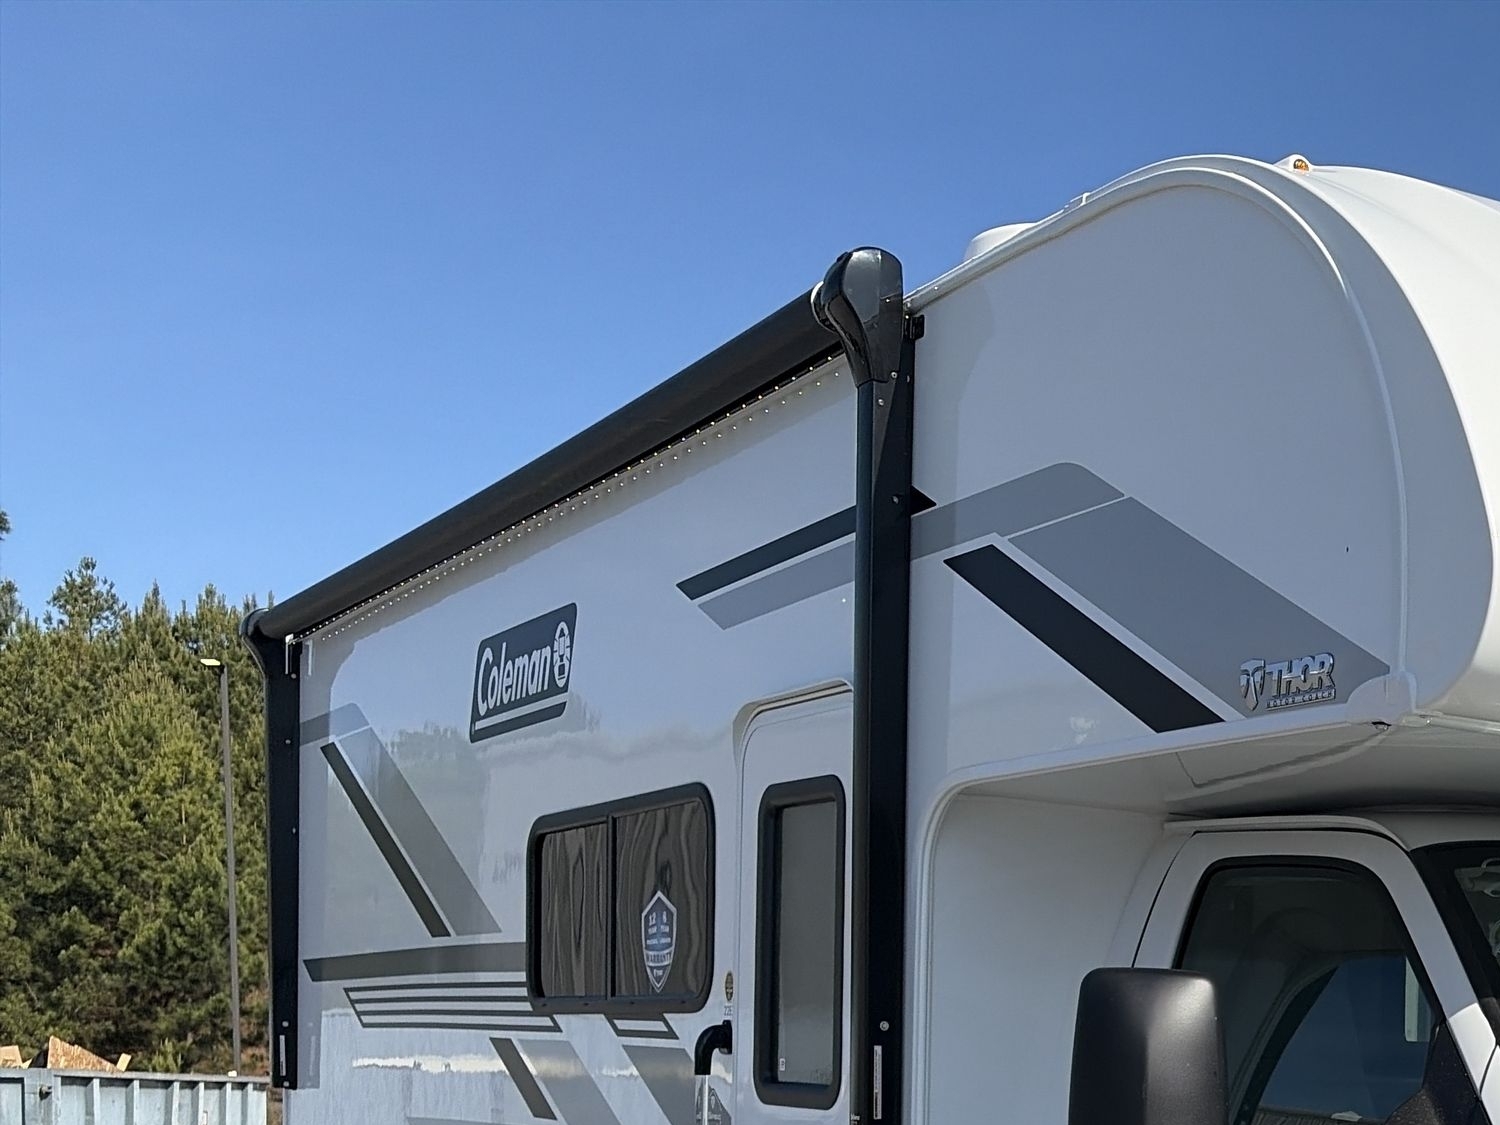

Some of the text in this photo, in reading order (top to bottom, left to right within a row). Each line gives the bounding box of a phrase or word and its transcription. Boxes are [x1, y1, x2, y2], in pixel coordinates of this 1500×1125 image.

[477, 641, 551, 716] Coleman
[1266, 652, 1336, 698] THOR
[1301, 689, 1333, 702] COACH
